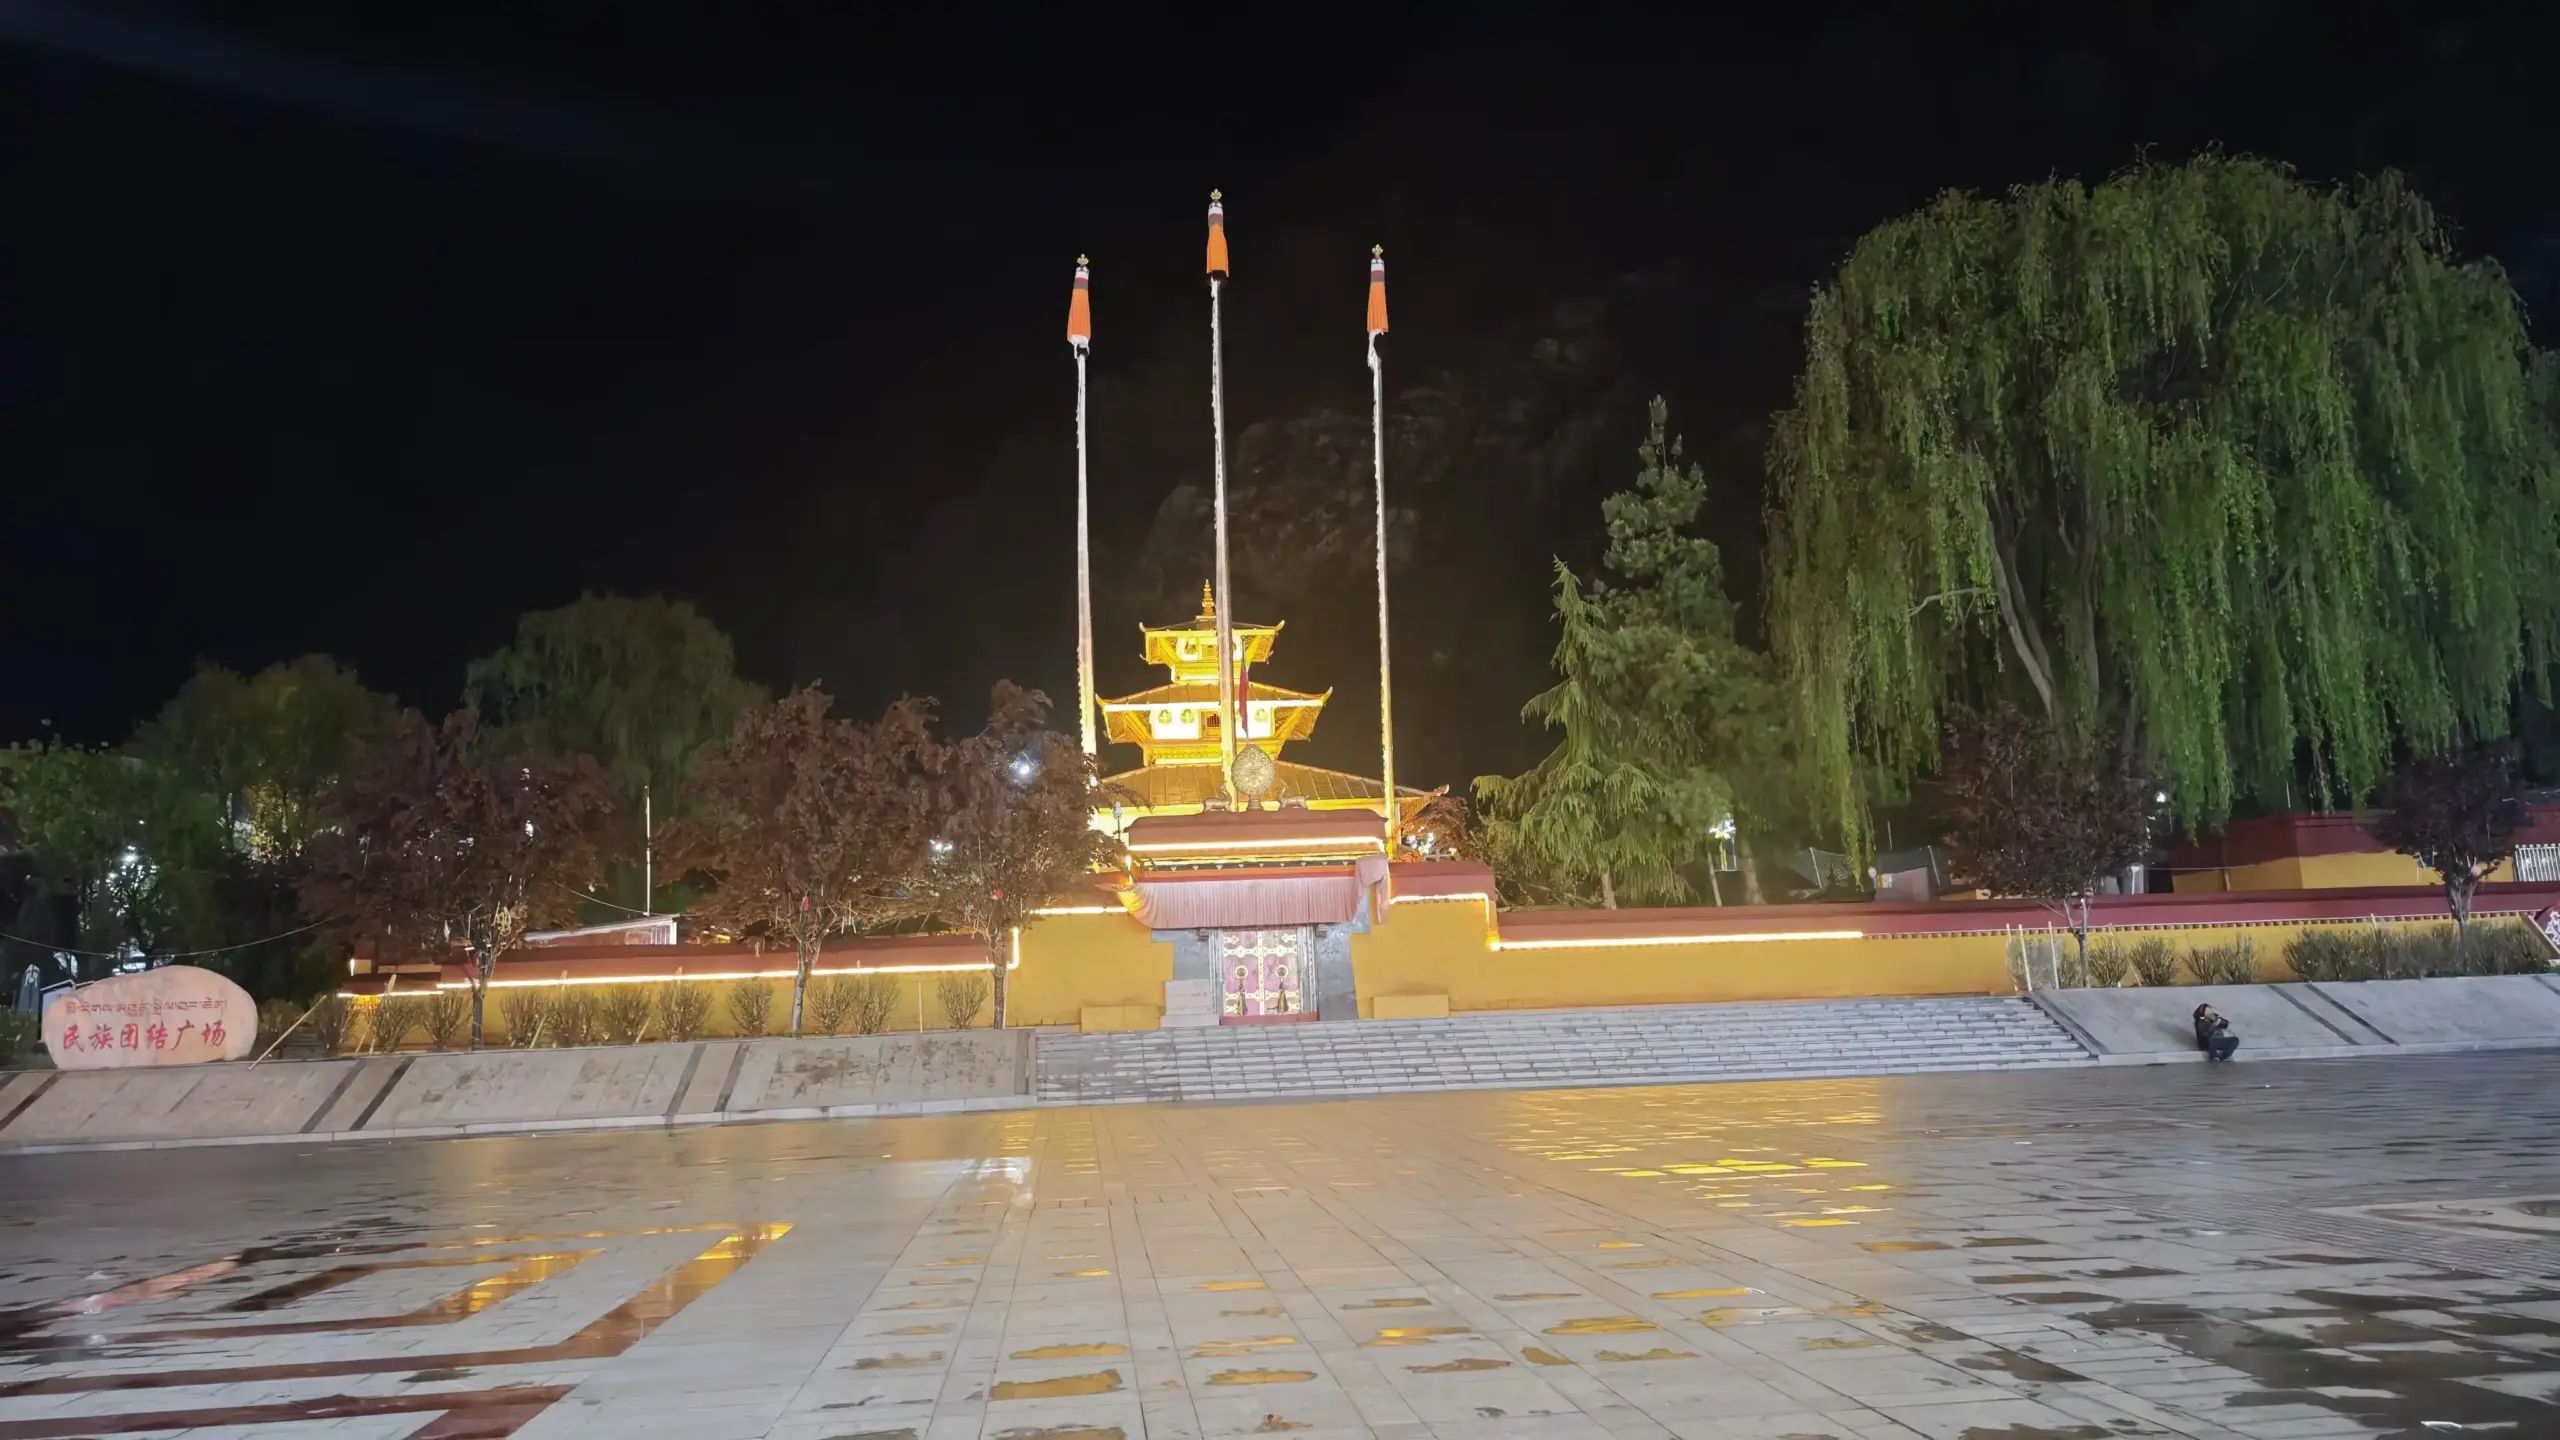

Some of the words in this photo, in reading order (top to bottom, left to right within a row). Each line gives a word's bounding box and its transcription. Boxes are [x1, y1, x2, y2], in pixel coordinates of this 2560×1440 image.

[63, 1020, 226, 1052] 民族团结广场
